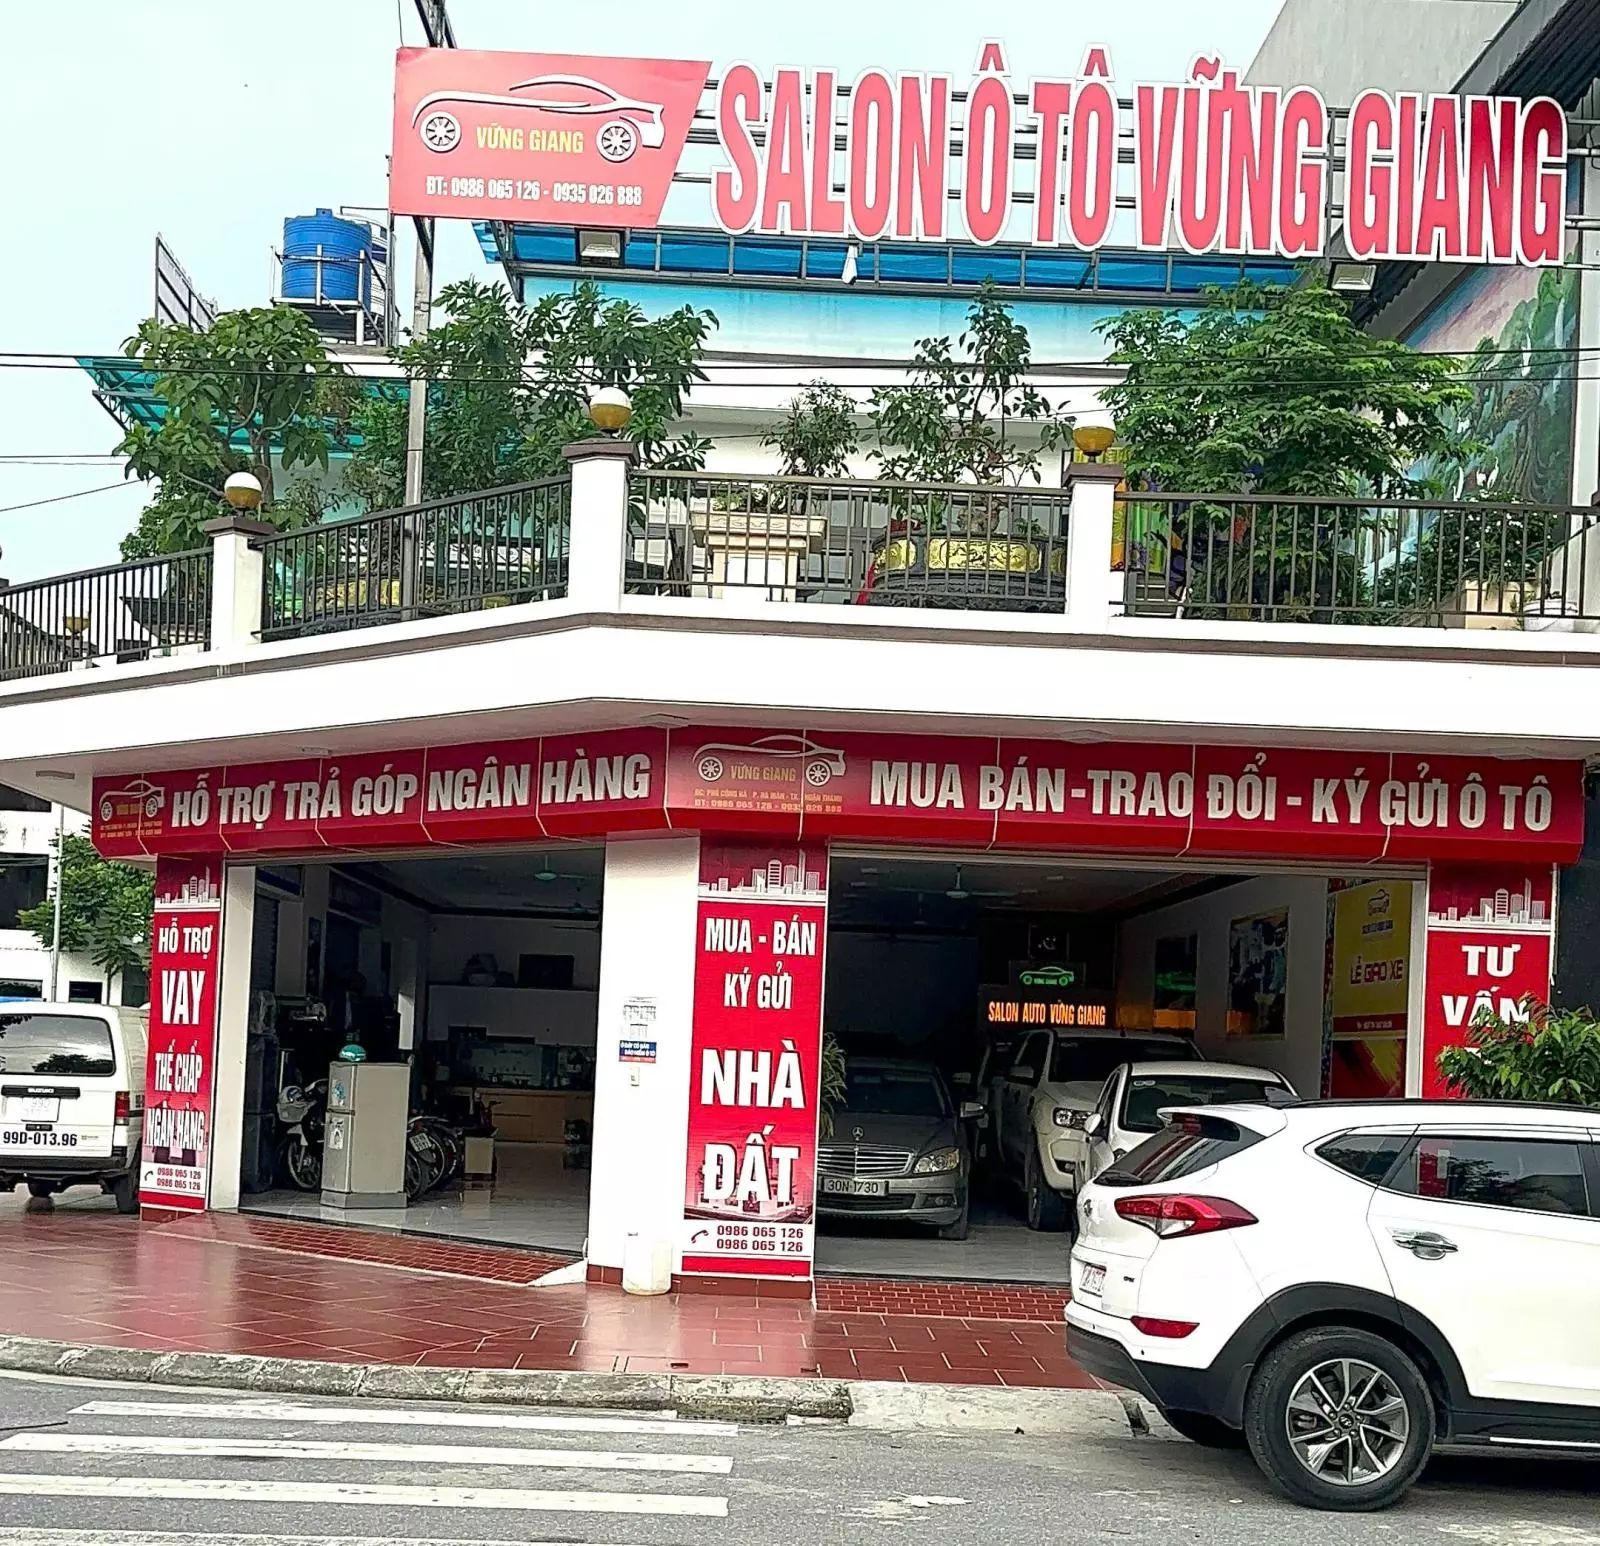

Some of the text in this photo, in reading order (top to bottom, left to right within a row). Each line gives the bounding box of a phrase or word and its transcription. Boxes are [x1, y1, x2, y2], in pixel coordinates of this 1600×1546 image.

[476, 122, 584, 153] VỮNG GIANG
[712, 39, 1567, 267] SALON Ô TÔ VỮNG GIANG
[451, 177, 484, 198] 0986
[488, 179, 513, 199] 065
[516, 180, 540, 200] 126
[553, 183, 586, 203] 0935
[589, 185, 613, 205] 026
[617, 186, 642, 206] 888
[171, 748, 650, 830] HỖ TRỢ TRẢ GÓP NGÂN HÀNG
[731, 763, 796, 782] VỮNG GIANG
[870, 760, 964, 809] MUA
[1206, 752, 1277, 821] ĐỔI
[1312, 767, 1369, 825] KÝ
[1380, 762, 1448, 829] GỬI
[1459, 772, 1486, 829] Ô
[1500, 775, 1552, 832] TÔ
[158, 917, 213, 959] HỖ TRỢ
[705, 917, 751, 954] MUA
[772, 914, 816, 956] BÁN
[1461, 944, 1521, 977] TƯ
[161, 970, 206, 1025] VAY
[724, 961, 792, 1010] KÝ GỬI
[1442, 986, 1529, 1027] VẤN
[988, 1001, 1019, 1022] SALON
[1022, 1002, 1046, 1023] AUTO
[1077, 1005, 1106, 1025] GIANG
[154, 1039, 203, 1094] THẾ CHẤP
[701, 1039, 805, 1109] NHÀ
[3, 1131, 77, 1147] 99D-013.96
[146, 1101, 205, 1151] NGÂN HÀNG
[702, 1124, 800, 1204] ĐẤT
[716, 1238, 803, 1254] 0986 065 126
[717, 1224, 804, 1240] 0986 065 126
